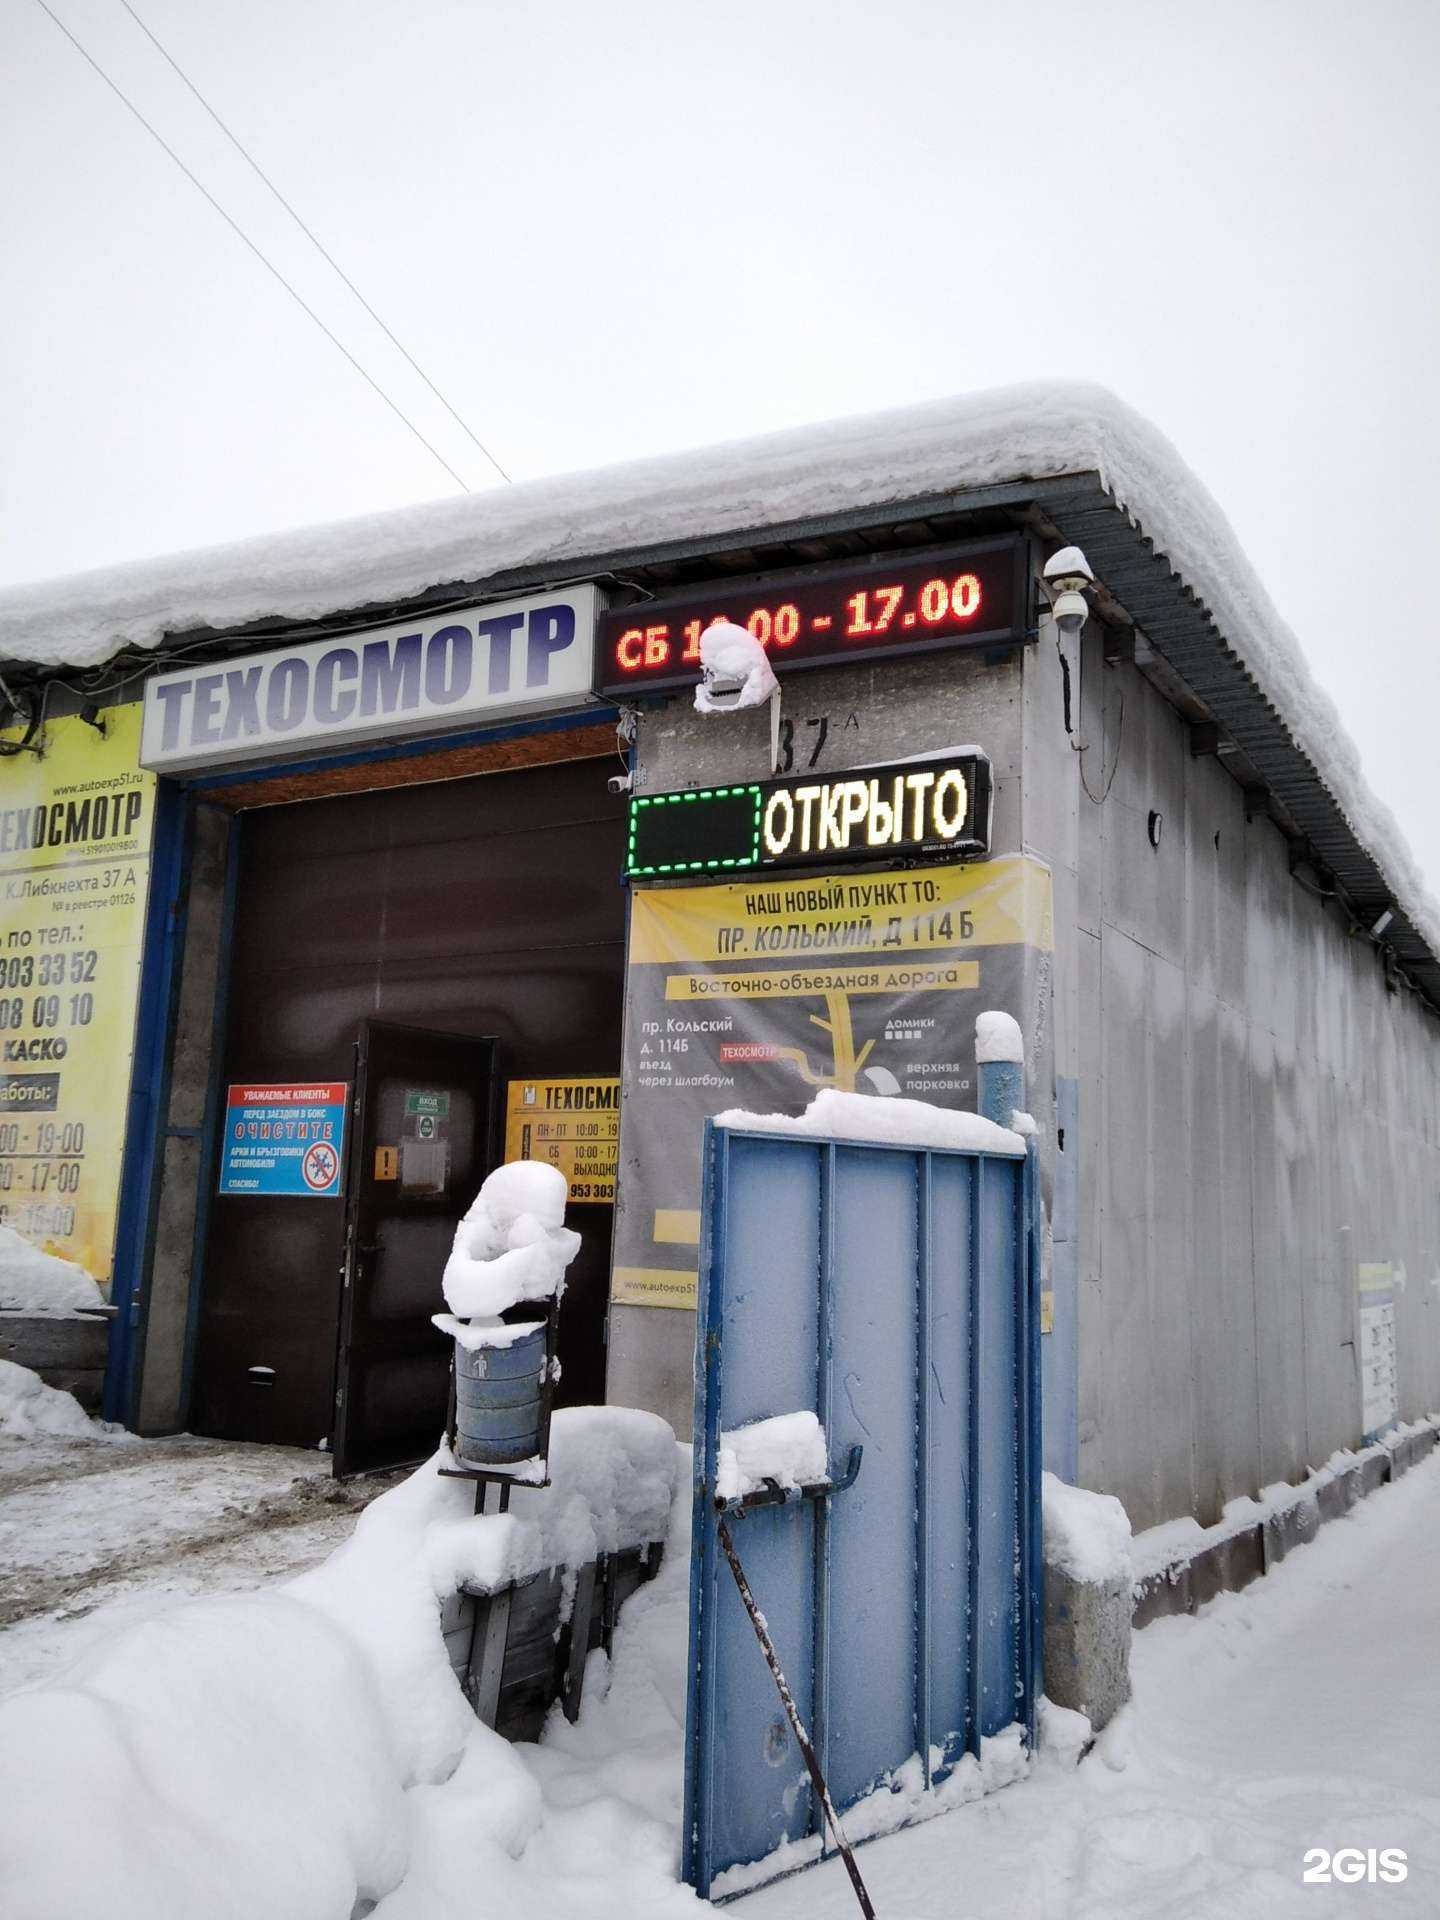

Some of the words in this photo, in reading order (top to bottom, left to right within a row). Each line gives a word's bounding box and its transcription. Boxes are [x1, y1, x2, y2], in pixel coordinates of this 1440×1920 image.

[617, 628, 669, 668] СБ
[682, 605, 799, 660] 100
[847, 574, 981, 634] 17.00
[156, 603, 576, 751] ТЕХОСМОТР
[53, 772, 144, 796] www.autoexp51.ru
[0, 791, 143, 853] ЕХОСМОТР
[763, 768, 968, 854] ОТКРЫТО
[103, 868, 121, 889] 37
[123, 867, 136, 887] А
[110, 893, 136, 907] 01126
[745, 893, 782, 916] НАШ
[785, 884, 844, 913] НОВЫЙ
[849, 881, 908, 908] ПУНКТ
[911, 879, 941, 902] ТО:
[8, 930, 32, 948] по
[38, 924, 84, 945] тел.:
[717, 926, 748, 954] ПР.
[754, 914, 877, 951] КОЛЬСКИЙ,
[882, 916, 903, 947] Д
[912, 911, 954, 943] 114
[959, 910, 975, 940] Б
[39, 953, 66, 986] 33
[70, 950, 98, 984] 52
[689, 971, 879, 995] Восточно-объездная
[884, 968, 958, 990] дорога
[33, 994, 60, 1028] 09
[70, 992, 94, 1026] 10
[641, 1020, 663, 1035] пр.
[666, 1016, 733, 1033] Кольский
[885, 1018, 936, 1031] домики
[4, 1037, 68, 1061] КАСКО
[640, 1042, 653, 1055] д.
[658, 1039, 689, 1053] 114Б
[639, 1060, 672, 1071] въезд
[906, 1062, 960, 1075] верхняя
[638, 1075, 672, 1088] через
[675, 1073, 735, 1088] шлагбаум
[906, 1079, 970, 1092] парковка
[243, 1090, 293, 1101] УВАЖАЕМЫЕ
[293, 1089, 330, 1100] КЛИЕНТЫ
[545, 1085, 620, 1110] ТЕХОСМО
[243, 1109, 266, 1120] ПЕРЕД
[307, 1108, 326, 1119] БОКС
[37, 1122, 84, 1153] 19-00
[235, 1121, 333, 1139] ОЧИСТИТЕ
[537, 1124, 549, 1137] ПН
[556, 1123, 568, 1137] ПТ
[576, 1123, 599, 1137] 10:00
[607, 1123, 618, 1137] 19
[548, 1145, 560, 1159] СБ
[575, 1145, 598, 1159] 10:00
[607, 1145, 617, 1159] 17
[32, 1162, 80, 1193] 17-00
[570, 1183, 591, 1198] 953
[593, 1184, 614, 1198] 303
